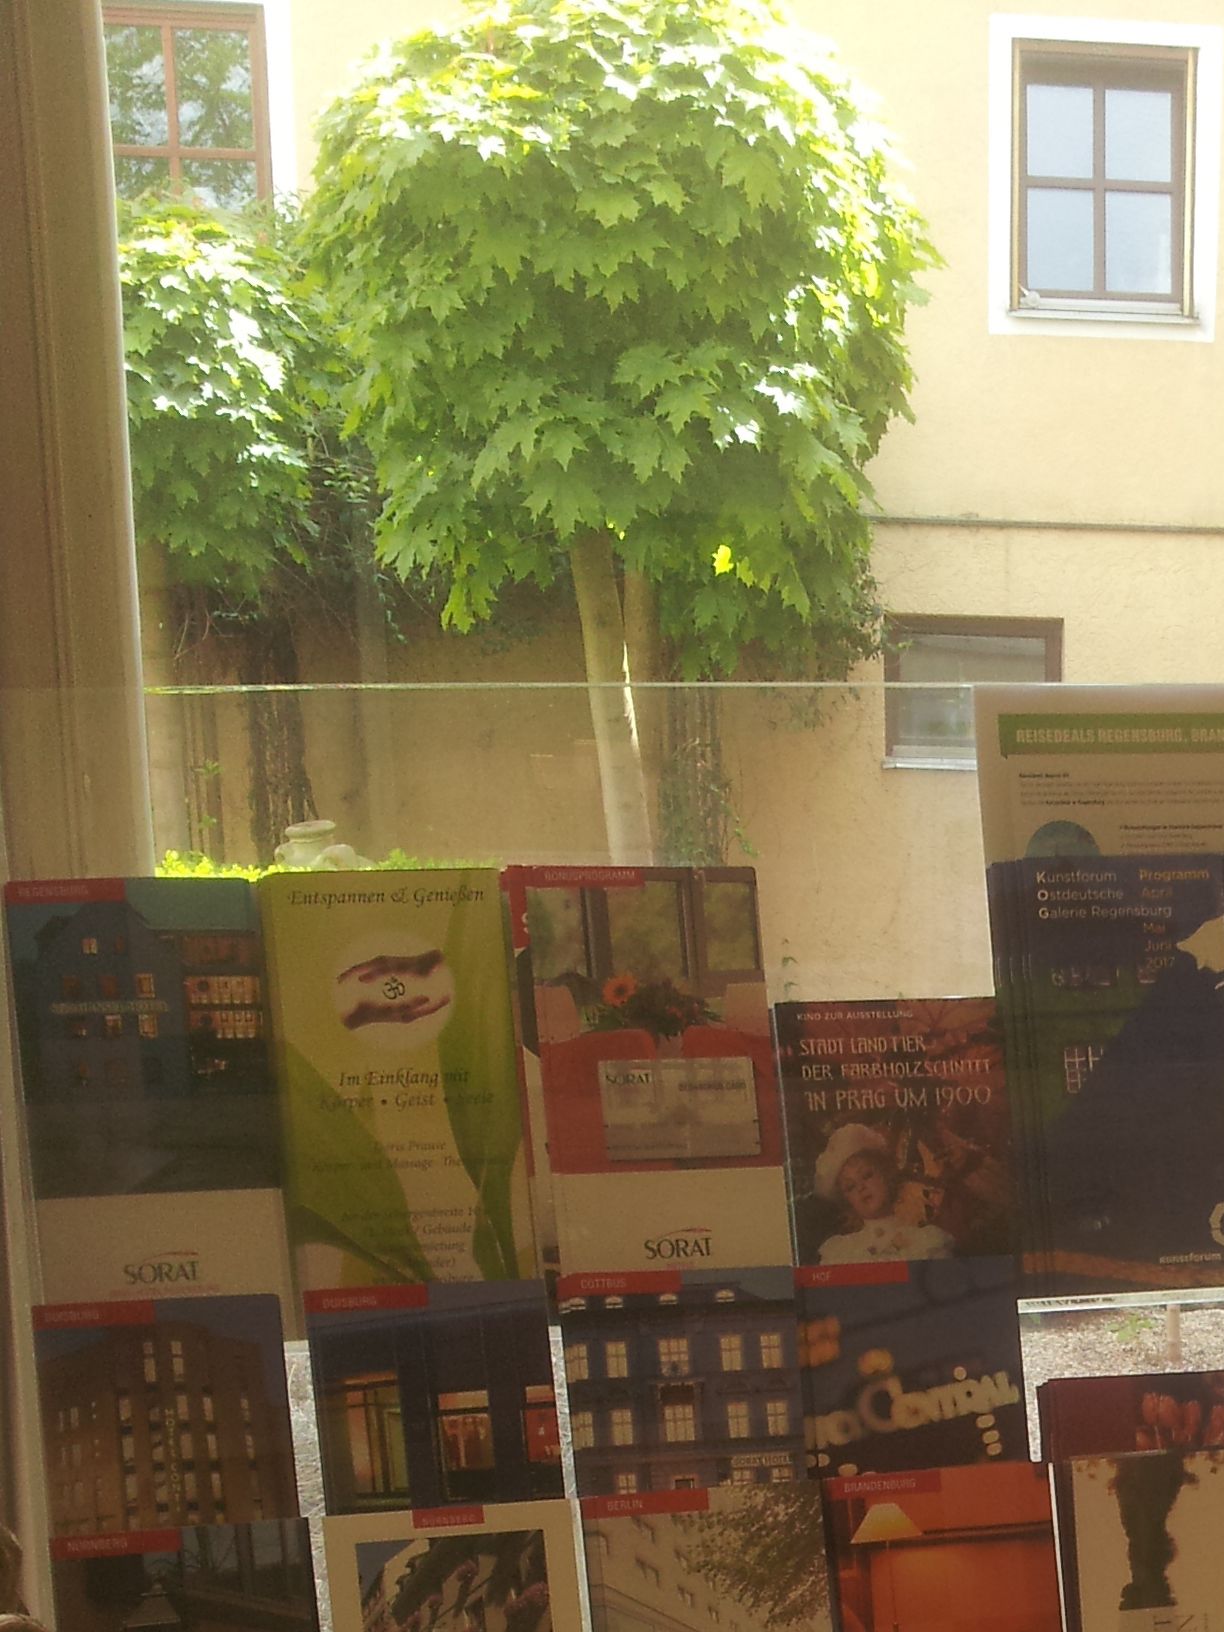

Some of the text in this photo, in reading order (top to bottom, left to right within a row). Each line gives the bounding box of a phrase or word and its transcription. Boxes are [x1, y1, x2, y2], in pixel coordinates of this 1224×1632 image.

[1016, 728, 1094, 743] REISEDEALS
[1036, 869, 1210, 884] Kunstforum Programm
[288, 885, 484, 909] Entspannen & Genießen
[1037, 888, 1124, 902] Ostdeutsche
[1038, 904, 1173, 920] Galerie Regensburg
[797, 1013, 821, 1021] KINO
[825, 1012, 844, 1021] ZUR
[799, 1037, 844, 1056] STADT
[850, 1036, 888, 1054] LAND
[339, 1072, 360, 1086] Im
[365, 1067, 439, 1089] Einklang
[802, 1063, 833, 1081] DER
[395, 1092, 435, 1111] Geist
[836, 1088, 886, 1110] PRAG
[895, 1087, 928, 1110] UM
[935, 1084, 992, 1105] 1900
[644, 1237, 712, 1260] SORAT
[123, 1261, 200, 1286] SORAT
[812, 1271, 832, 1281] HOF
[580, 1278, 626, 1289] COTTBUS
[844, 1478, 917, 1493] BRANDENBURG
[607, 1500, 643, 1511] BERLIN
